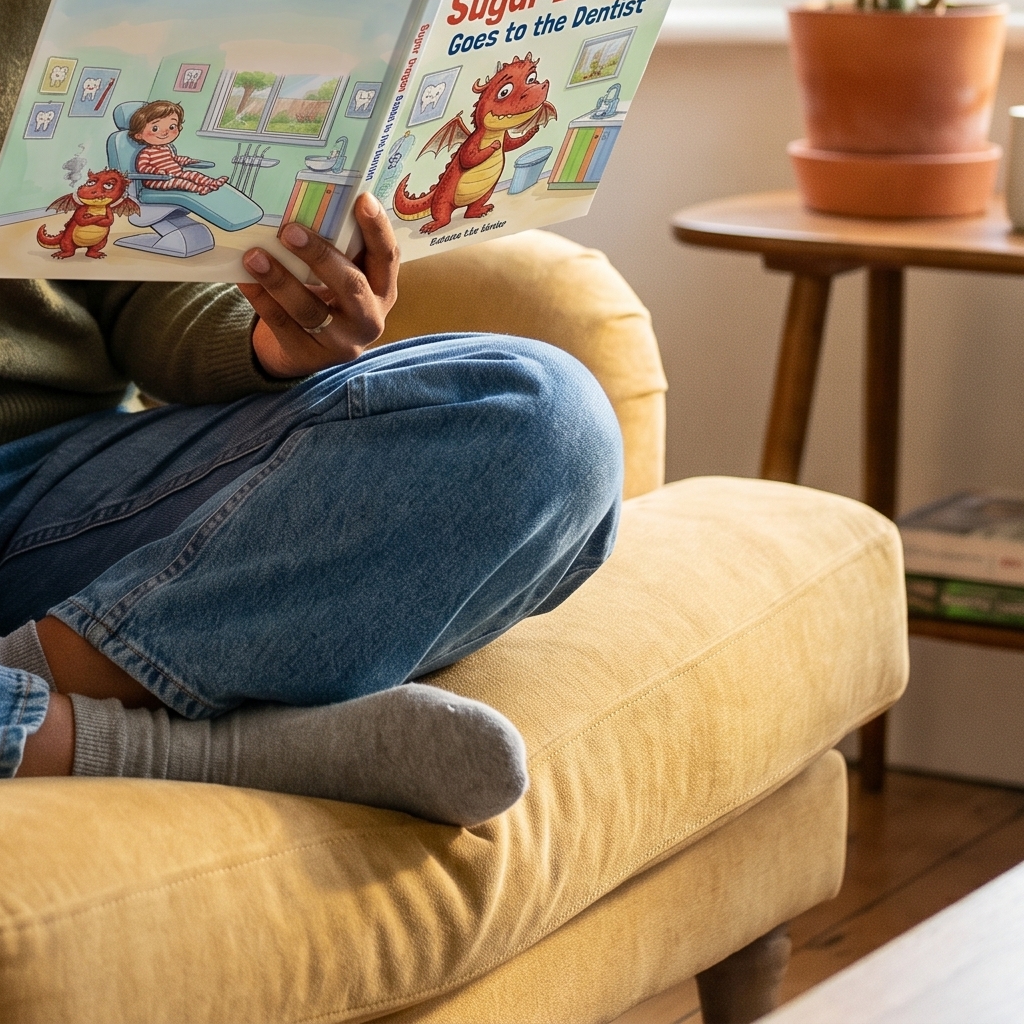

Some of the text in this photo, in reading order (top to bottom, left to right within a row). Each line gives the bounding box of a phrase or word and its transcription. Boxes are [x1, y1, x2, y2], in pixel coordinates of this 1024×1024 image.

[448, 29, 499, 55] Goes
[505, 22, 527, 43] to
[533, 13, 567, 36] the
